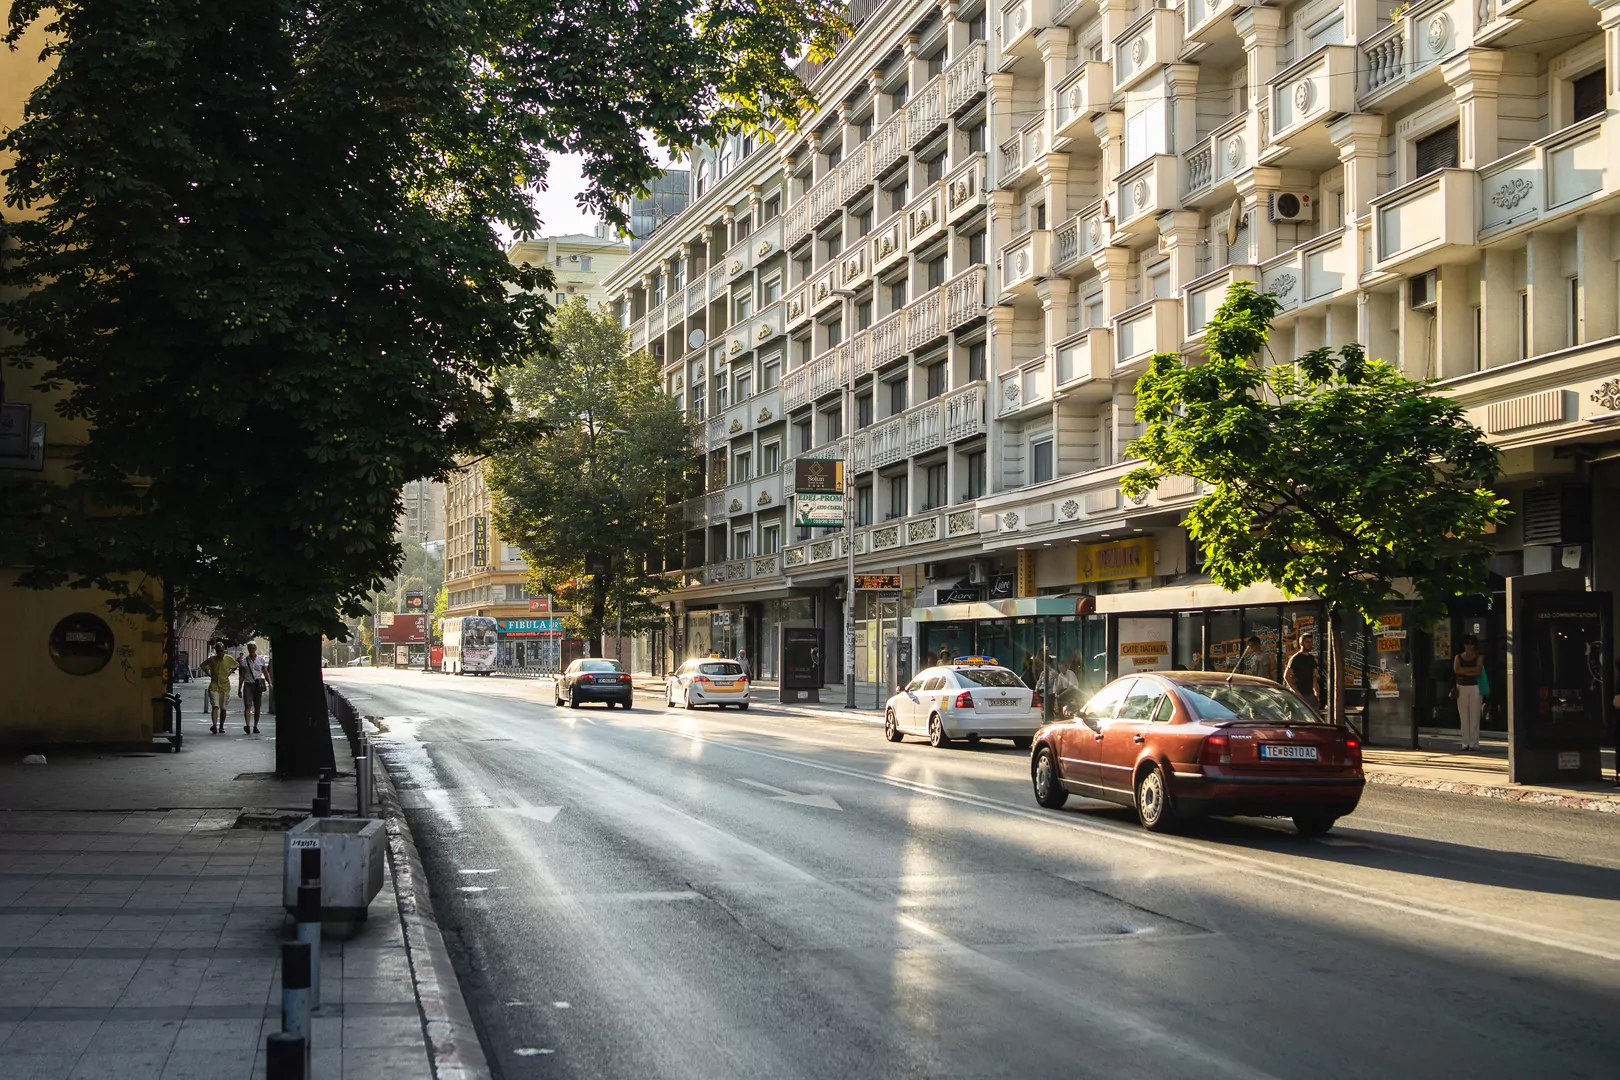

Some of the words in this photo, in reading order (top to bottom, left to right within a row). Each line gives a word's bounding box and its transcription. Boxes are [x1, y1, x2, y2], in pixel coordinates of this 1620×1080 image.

[476, 518, 486, 566] Varumin
[508, 620, 547, 629] FIBULA
[1122, 645, 1139, 654] СИТЕ
